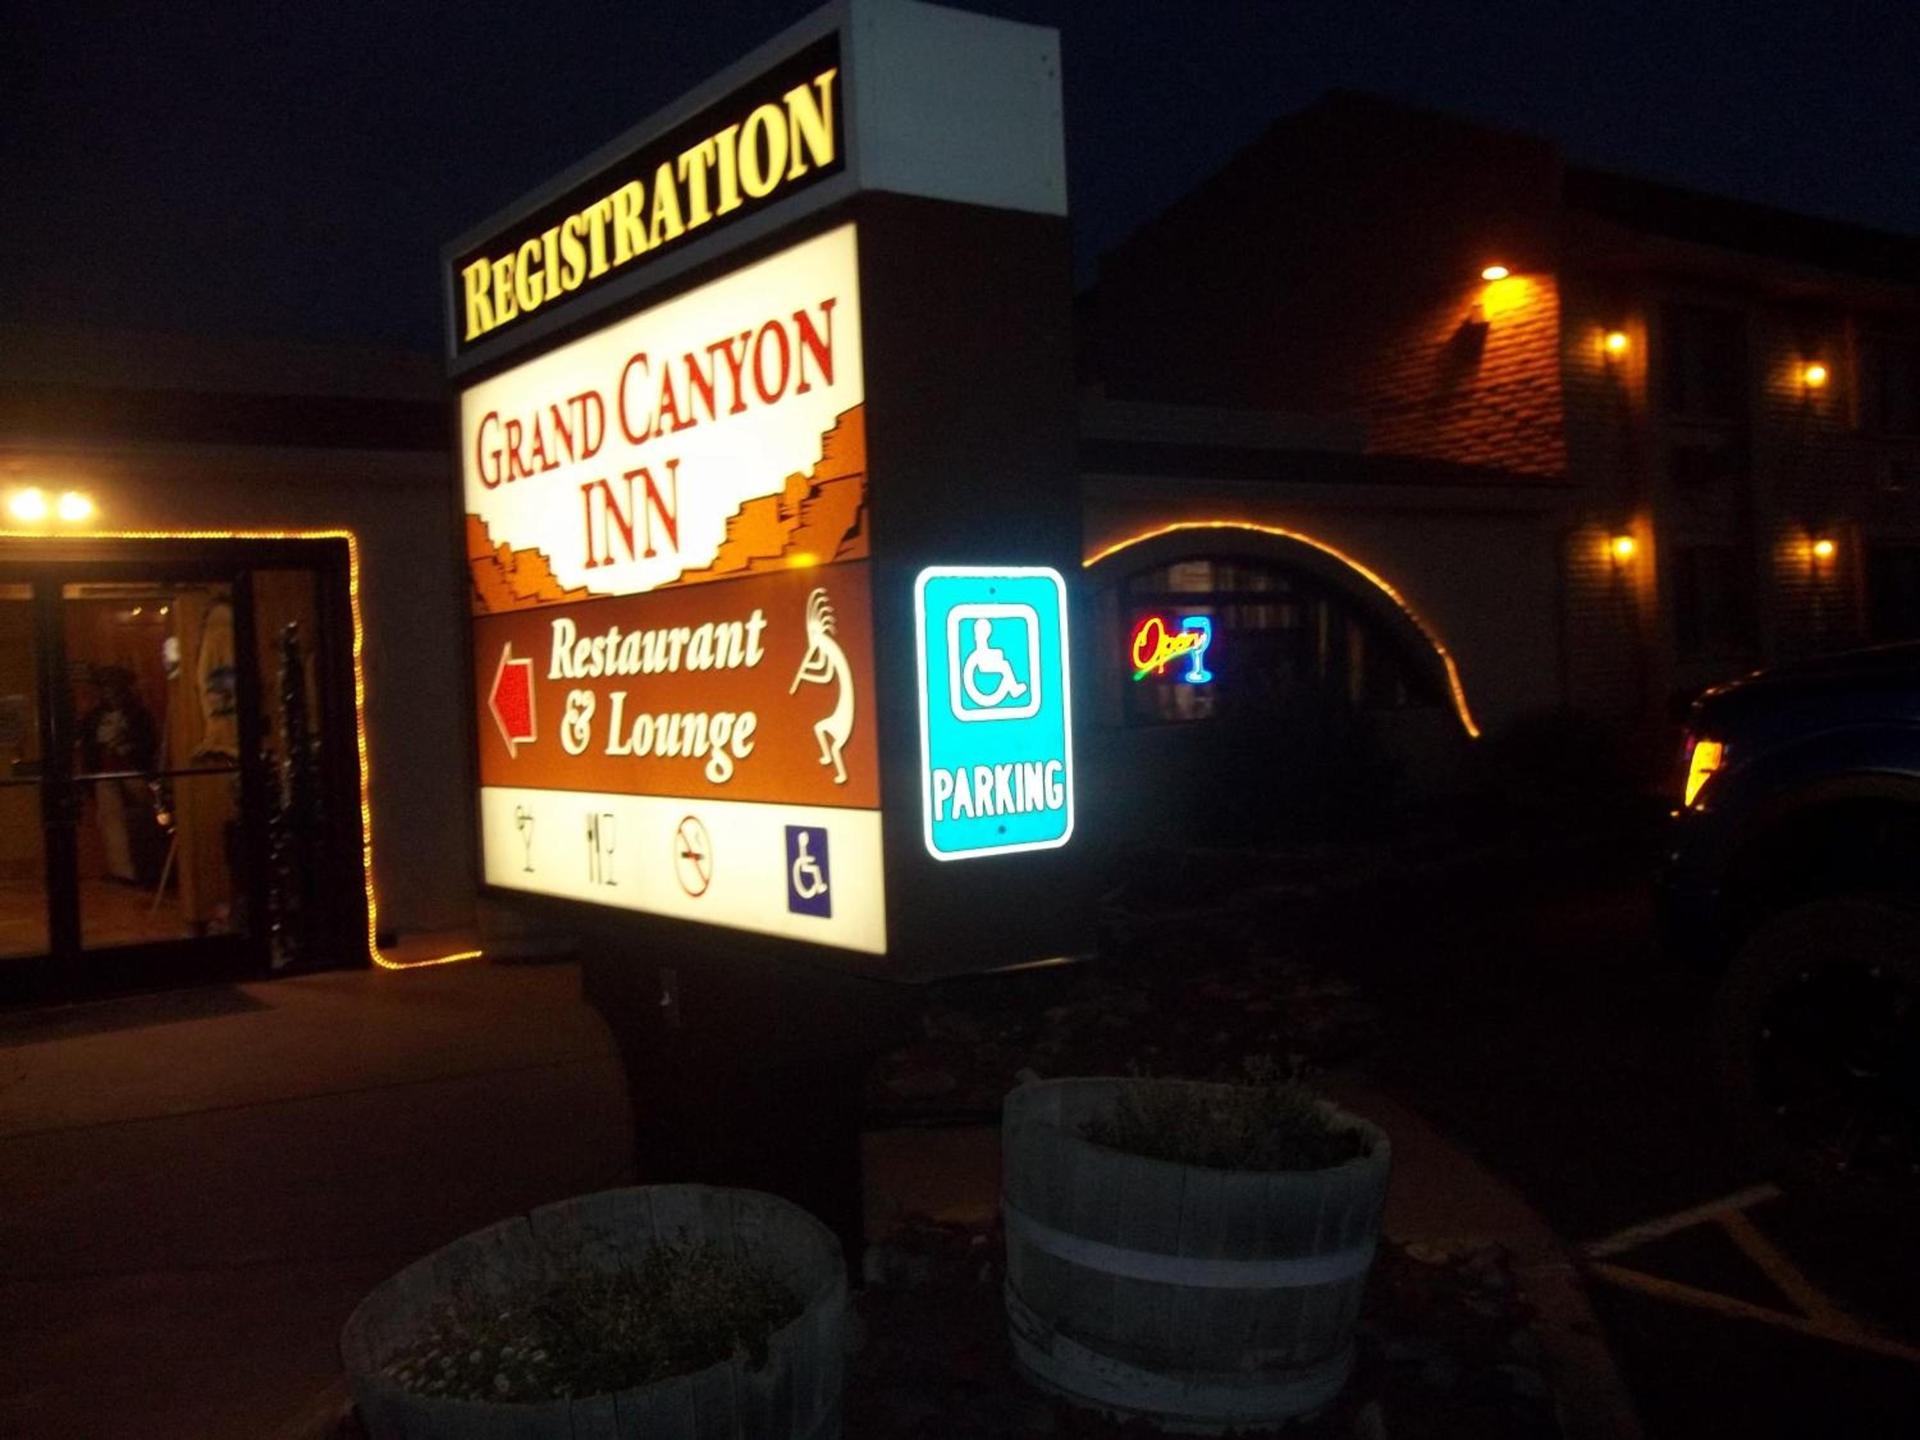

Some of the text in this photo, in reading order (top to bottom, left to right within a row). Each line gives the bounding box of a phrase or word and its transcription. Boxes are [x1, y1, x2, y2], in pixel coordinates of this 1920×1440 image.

[462, 68, 837, 342] REGISTRATION
[477, 297, 837, 489] GRAND CANYON
[580, 458, 680, 569] INN
[547, 609, 767, 680] Restaurant
[1133, 617, 1207, 673] Open
[560, 689, 757, 784] & Lounge
[932, 760, 1064, 822] PARKING
